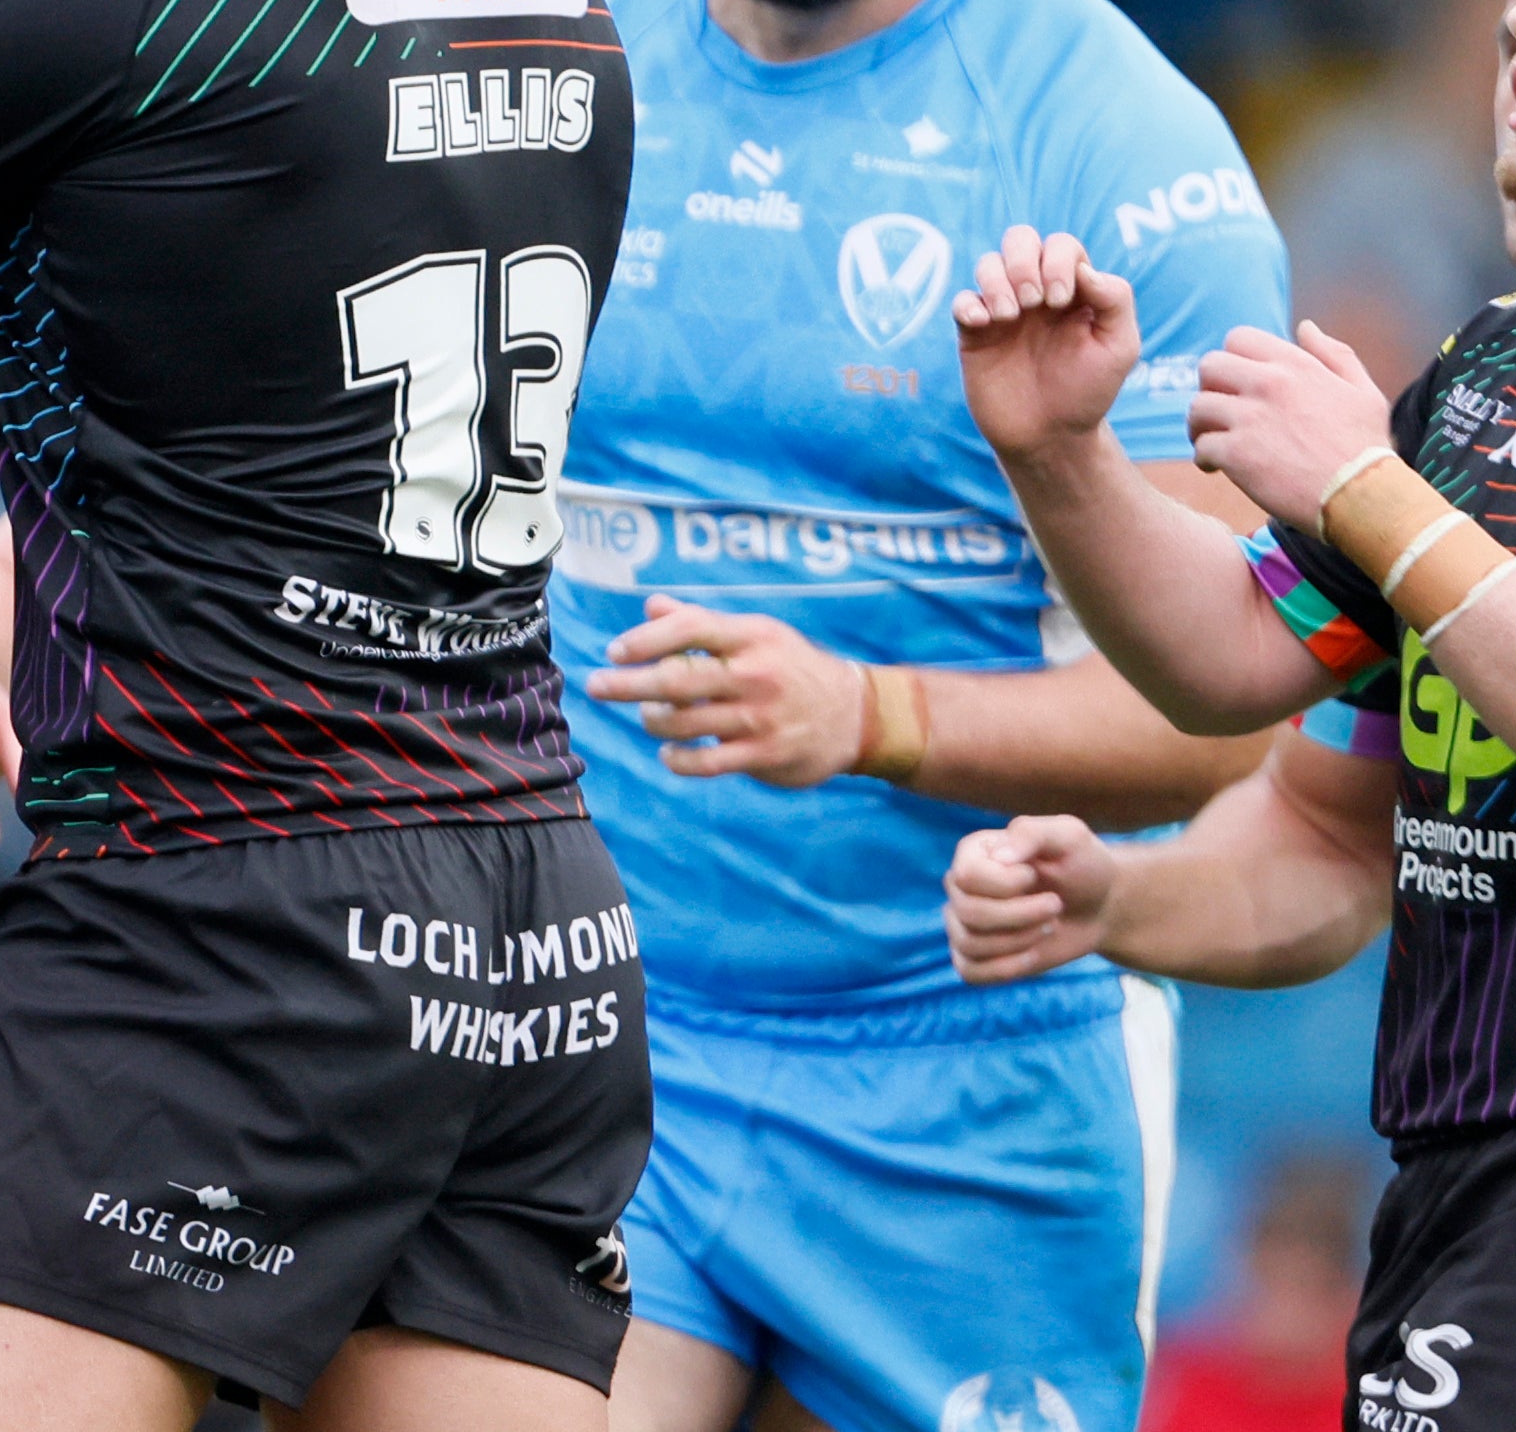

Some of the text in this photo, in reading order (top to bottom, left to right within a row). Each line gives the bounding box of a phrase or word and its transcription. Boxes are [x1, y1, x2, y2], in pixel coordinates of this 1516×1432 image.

[386, 68, 595, 163] ELLIS
[336, 244, 592, 576] 13
[676, 506, 1006, 575] bargains
[273, 574, 414, 647] STEVE
[347, 907, 481, 983] LOCH
[83, 1191, 296, 1277] FASE GROUP
[128, 1248, 226, 1294] LIMITED
